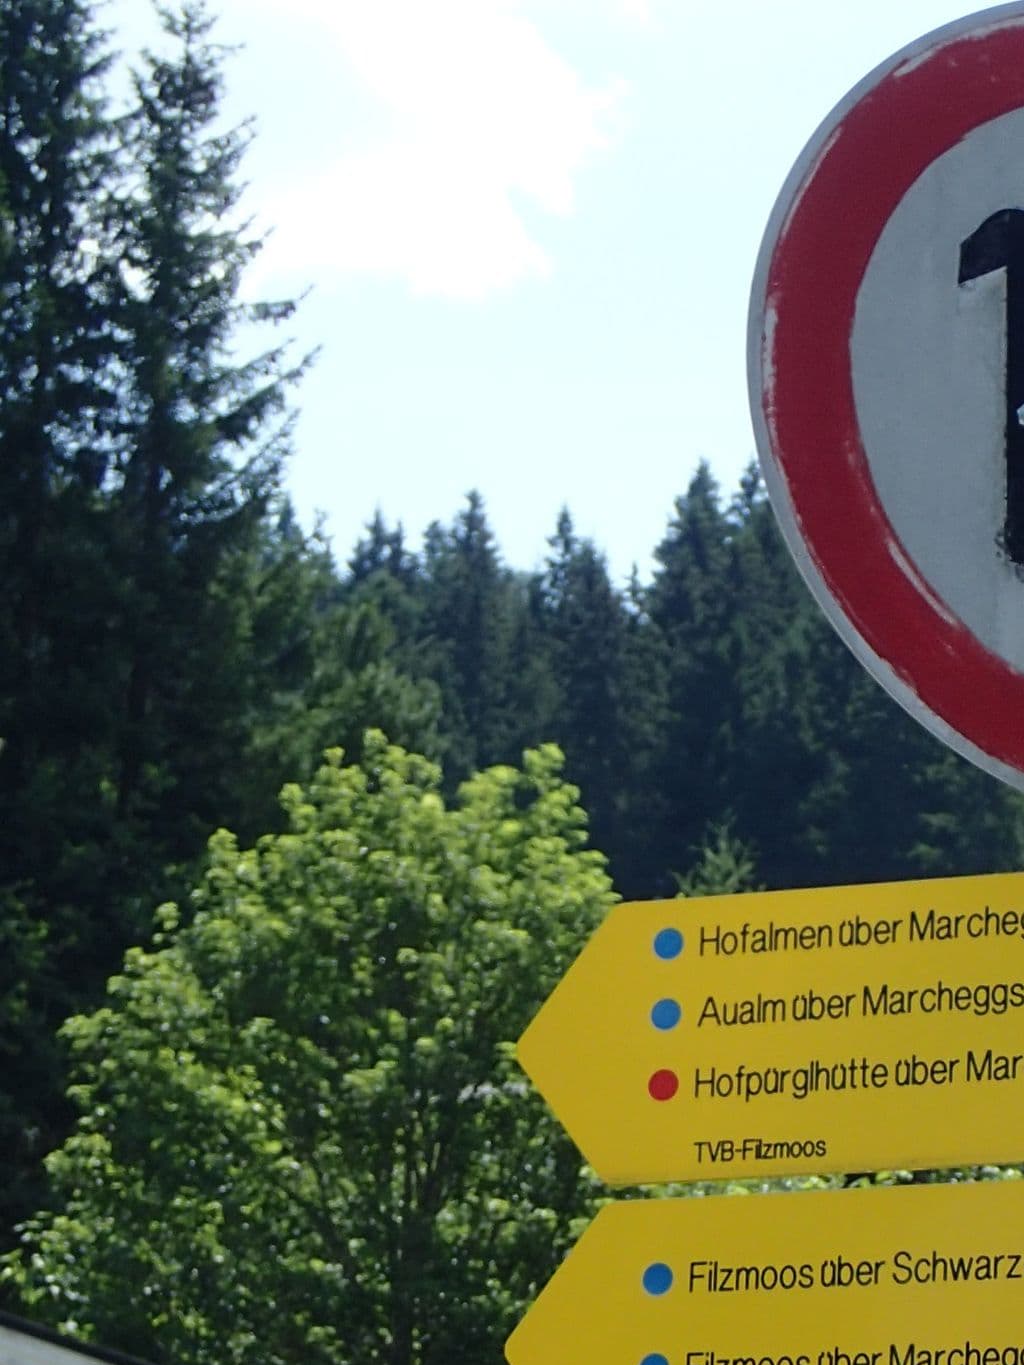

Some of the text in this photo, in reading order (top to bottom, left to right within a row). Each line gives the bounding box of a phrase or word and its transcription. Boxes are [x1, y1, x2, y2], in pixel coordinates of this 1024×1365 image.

[699, 915, 833, 957] Hofalmen
[838, 915, 902, 946] über
[697, 992, 787, 1028] Aualm
[791, 990, 853, 1020] über
[694, 1058, 889, 1102] Hofpürglhütte
[894, 1057, 959, 1087] über
[694, 1138, 827, 1164] TVB-Filzmoos
[688, 1260, 814, 1294] Filzmoos
[820, 1255, 885, 1288] über
